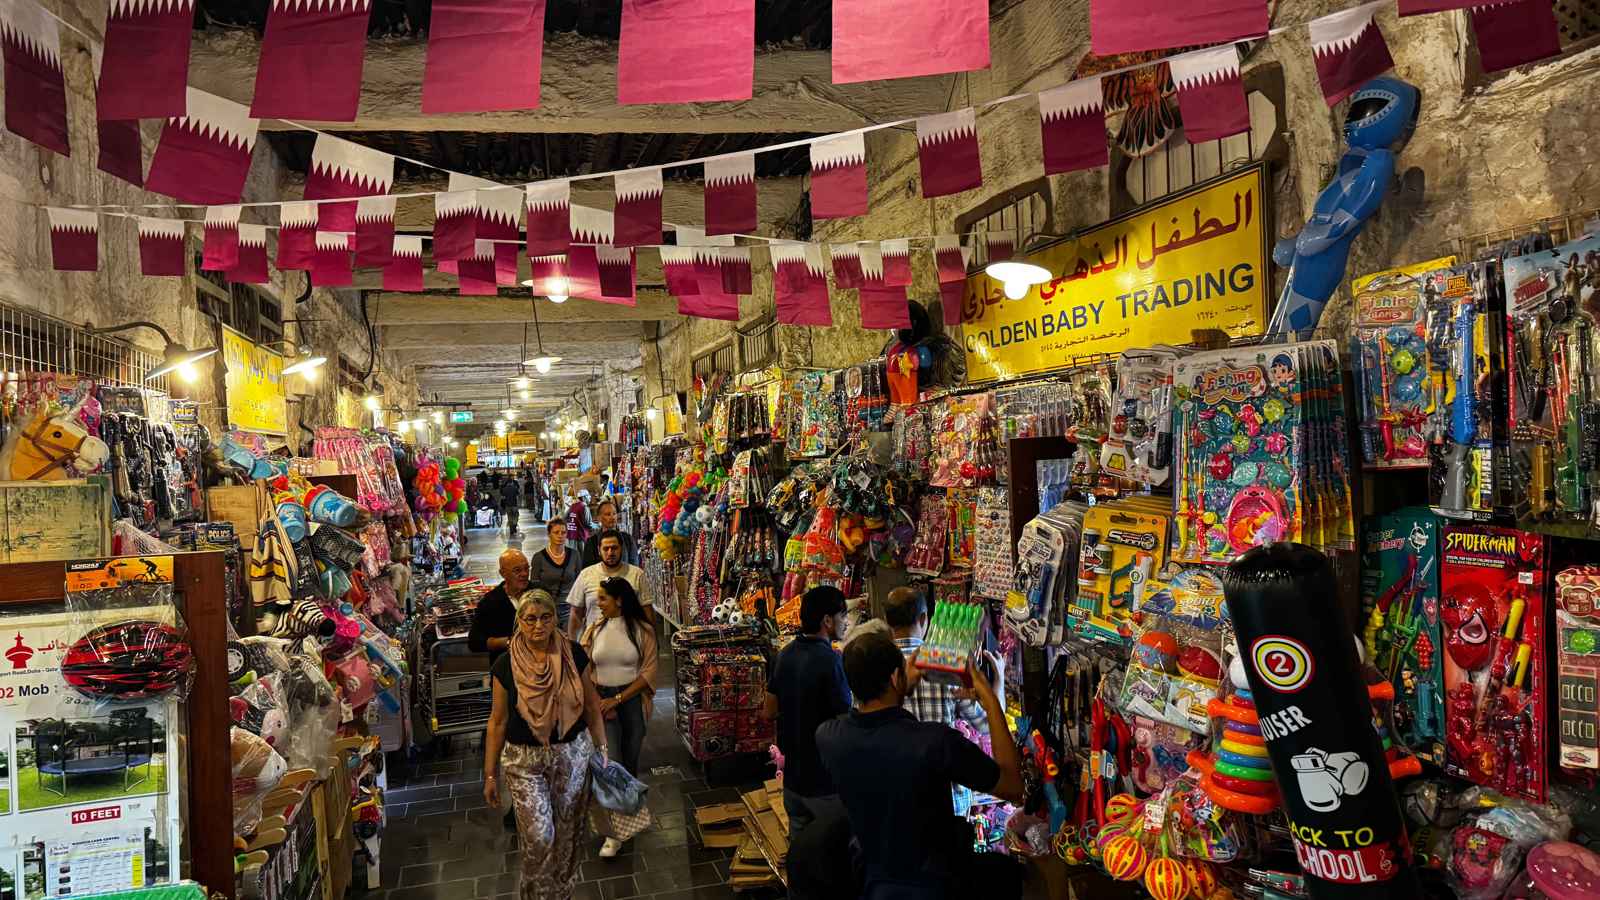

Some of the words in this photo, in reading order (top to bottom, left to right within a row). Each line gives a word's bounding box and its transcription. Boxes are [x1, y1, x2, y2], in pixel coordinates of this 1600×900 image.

[1136, 188, 1252, 270] الطفل
[1040, 234, 1129, 306] الذهبي
[966, 318, 1037, 353] GOLDEN
[1041, 300, 1104, 337] BABY
[1116, 263, 1254, 319] TRADING
[1271, 653, 1289, 673] 2
[19, 683, 50, 697] Mob
[1260, 705, 1312, 741] UISER
[73, 811, 87, 822] 10
[90, 807, 120, 820] FEET
[1290, 821, 1327, 848] ACK
[1334, 827, 1374, 848] TO
[1296, 838, 1377, 883] CHOOL
